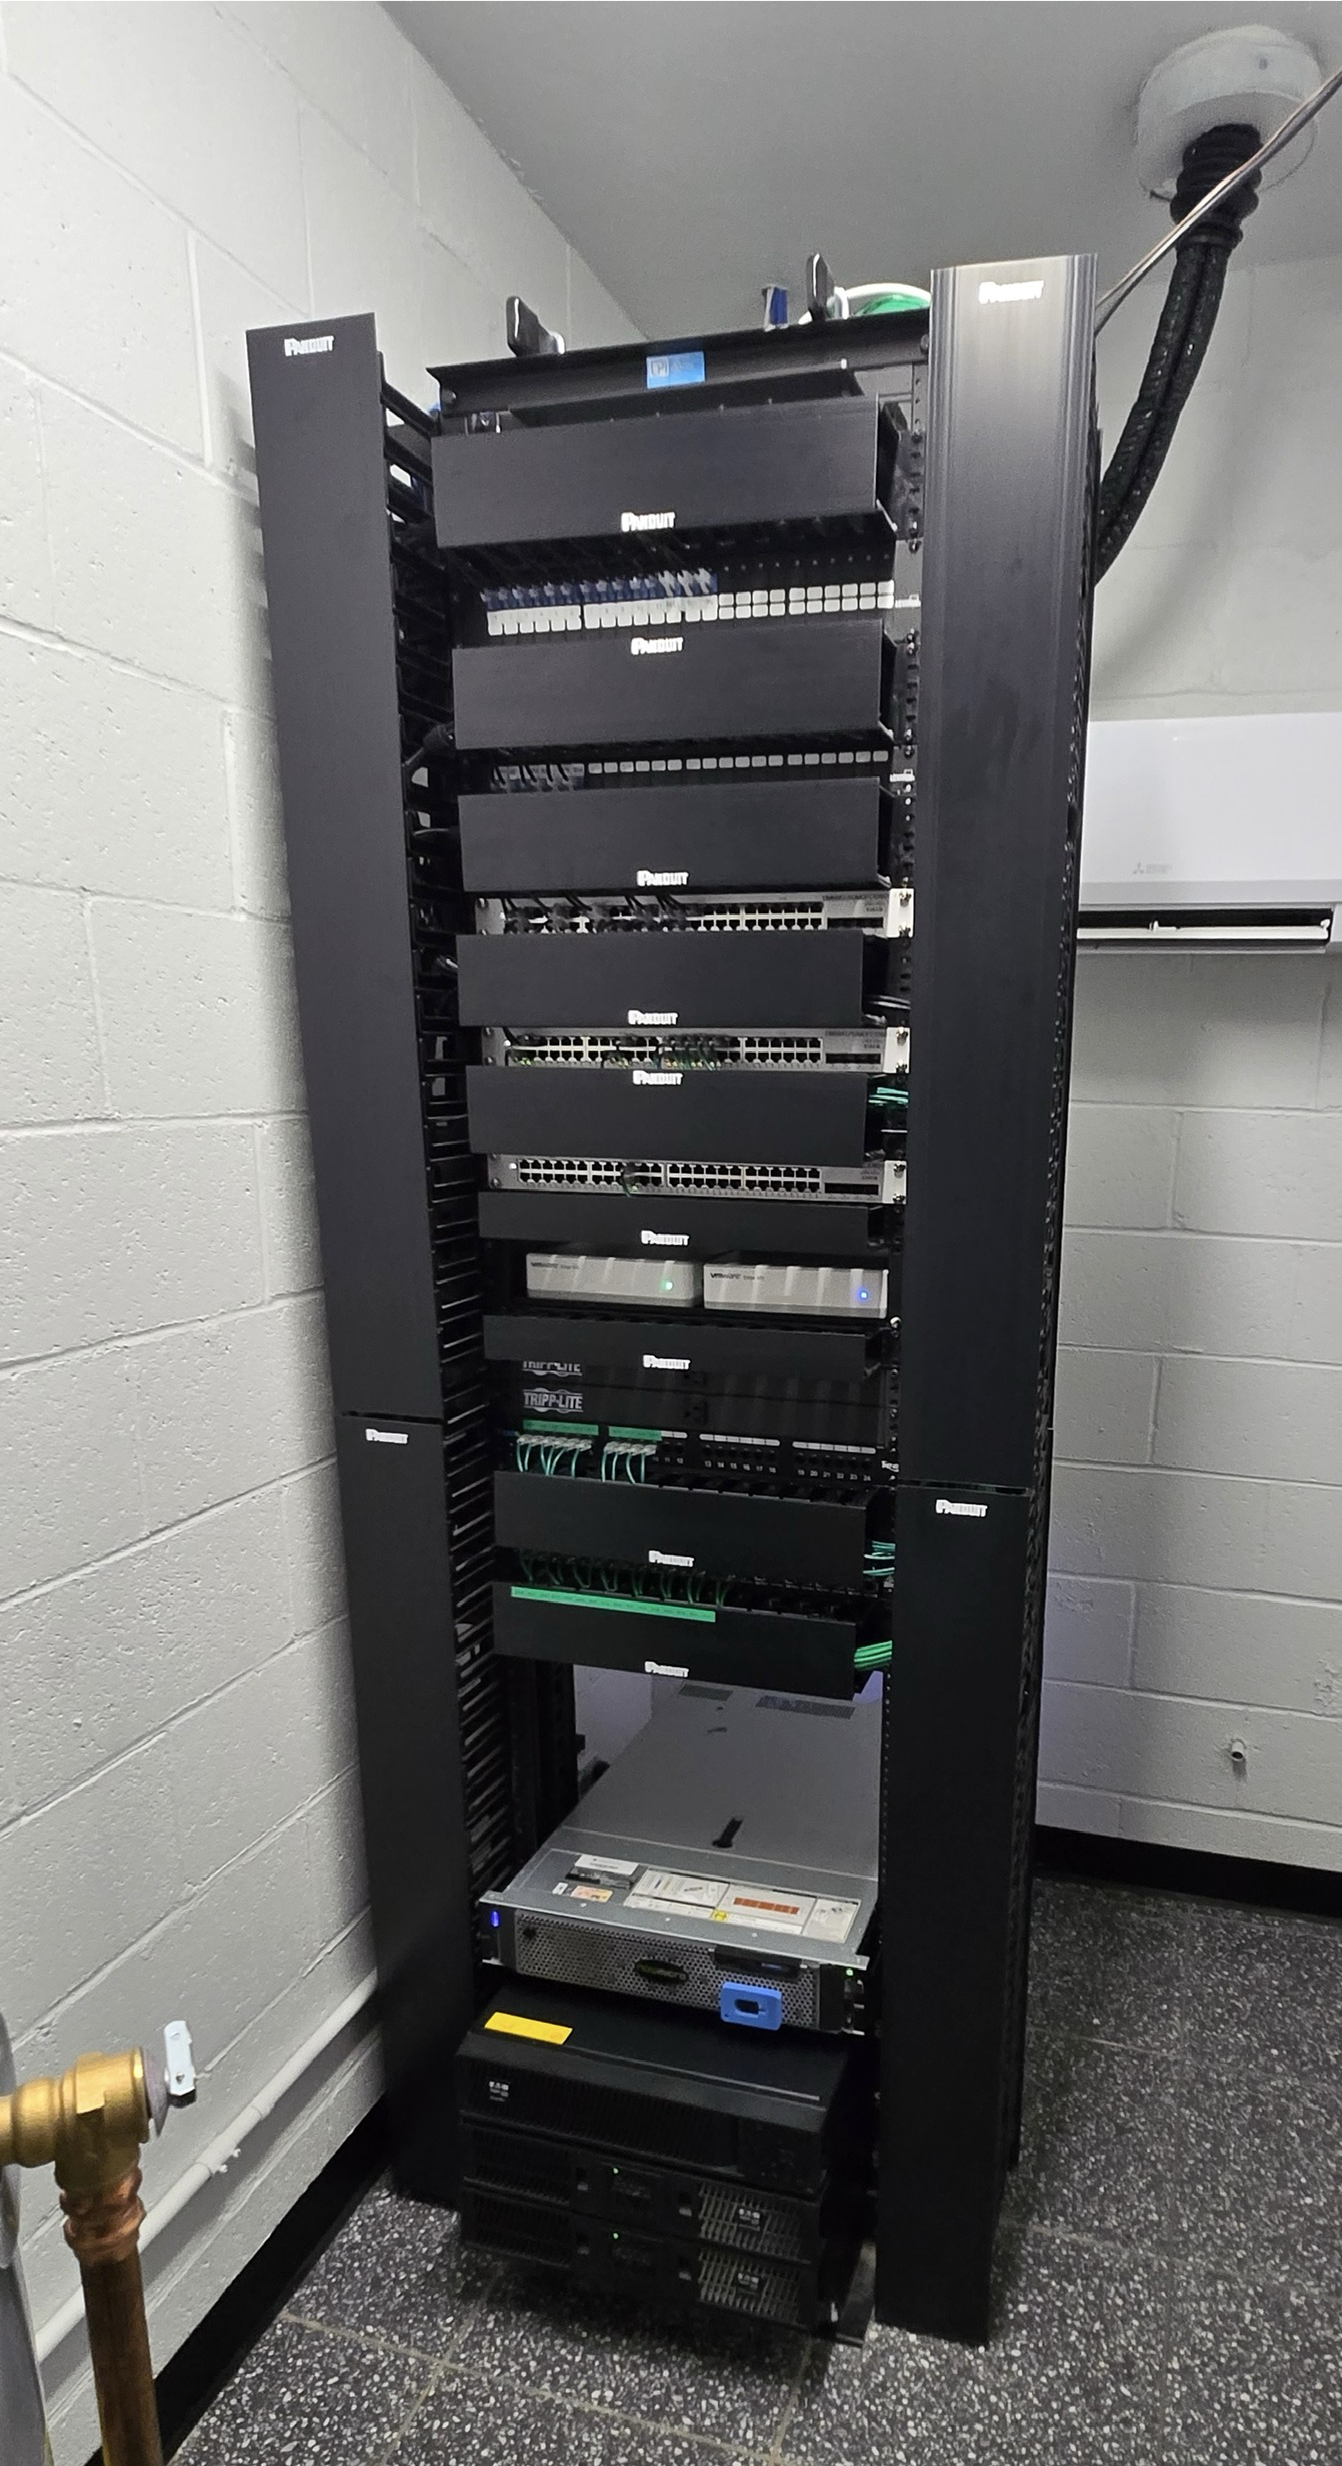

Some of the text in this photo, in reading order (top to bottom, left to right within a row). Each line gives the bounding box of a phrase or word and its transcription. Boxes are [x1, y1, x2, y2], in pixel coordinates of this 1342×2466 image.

[284, 335, 334, 356] PANDUIT
[621, 512, 675, 532] PANDUIT
[631, 637, 683, 655] PANDUIT
[637, 870, 689, 886] PANDUIT
